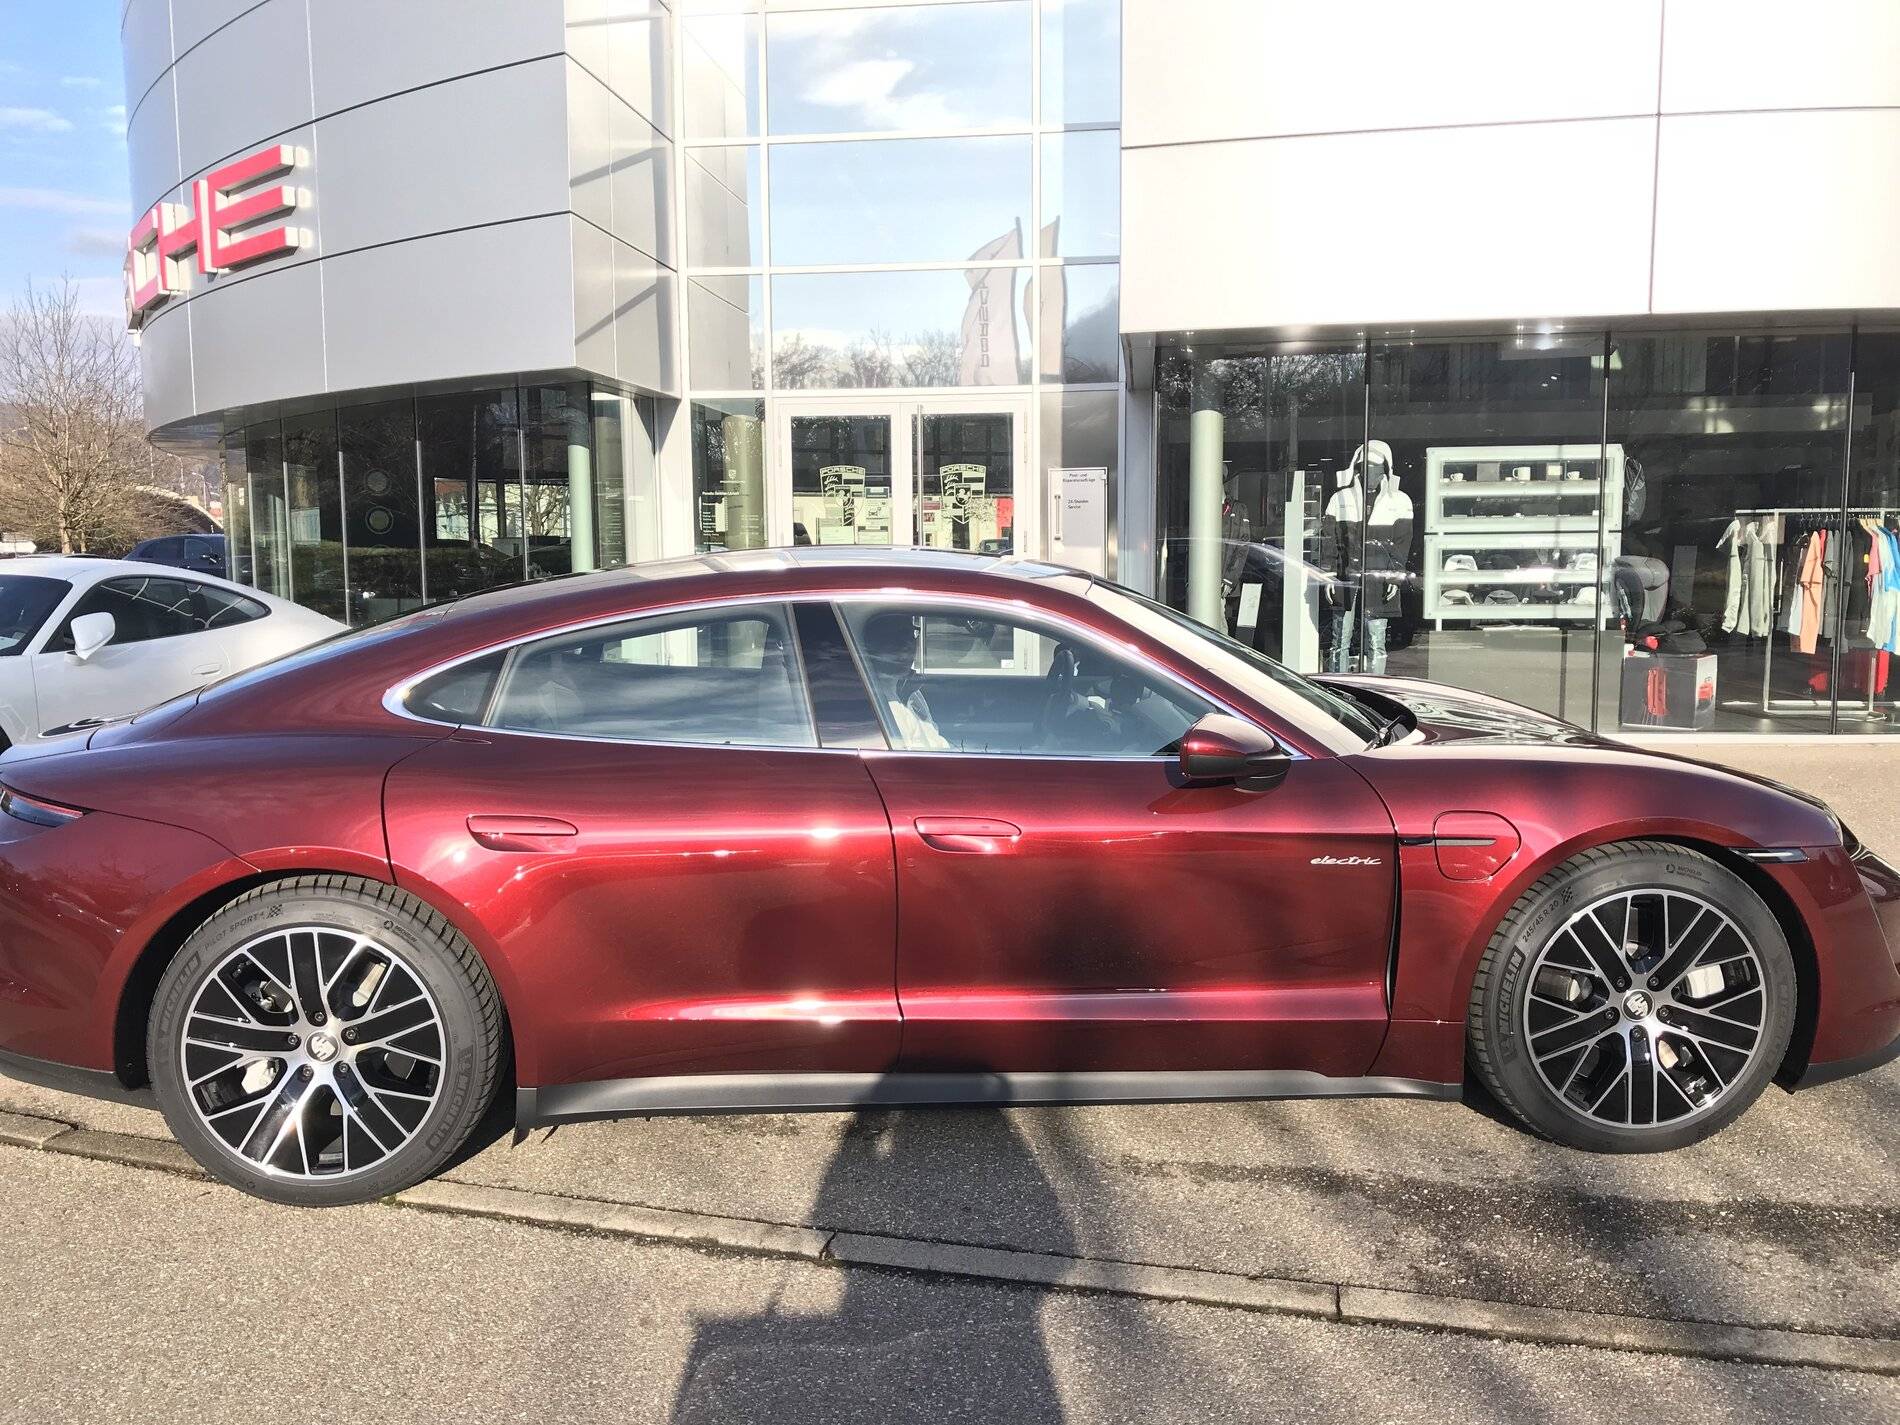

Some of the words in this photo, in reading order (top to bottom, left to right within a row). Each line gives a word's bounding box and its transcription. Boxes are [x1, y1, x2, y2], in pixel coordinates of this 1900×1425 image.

[127, 144, 298, 314] CHE
[1310, 855, 1382, 865] electric
[1522, 913, 1545, 943] 245/45
[1549, 899, 1559, 911] 20
[1498, 950, 1523, 1036] MICHELIN
